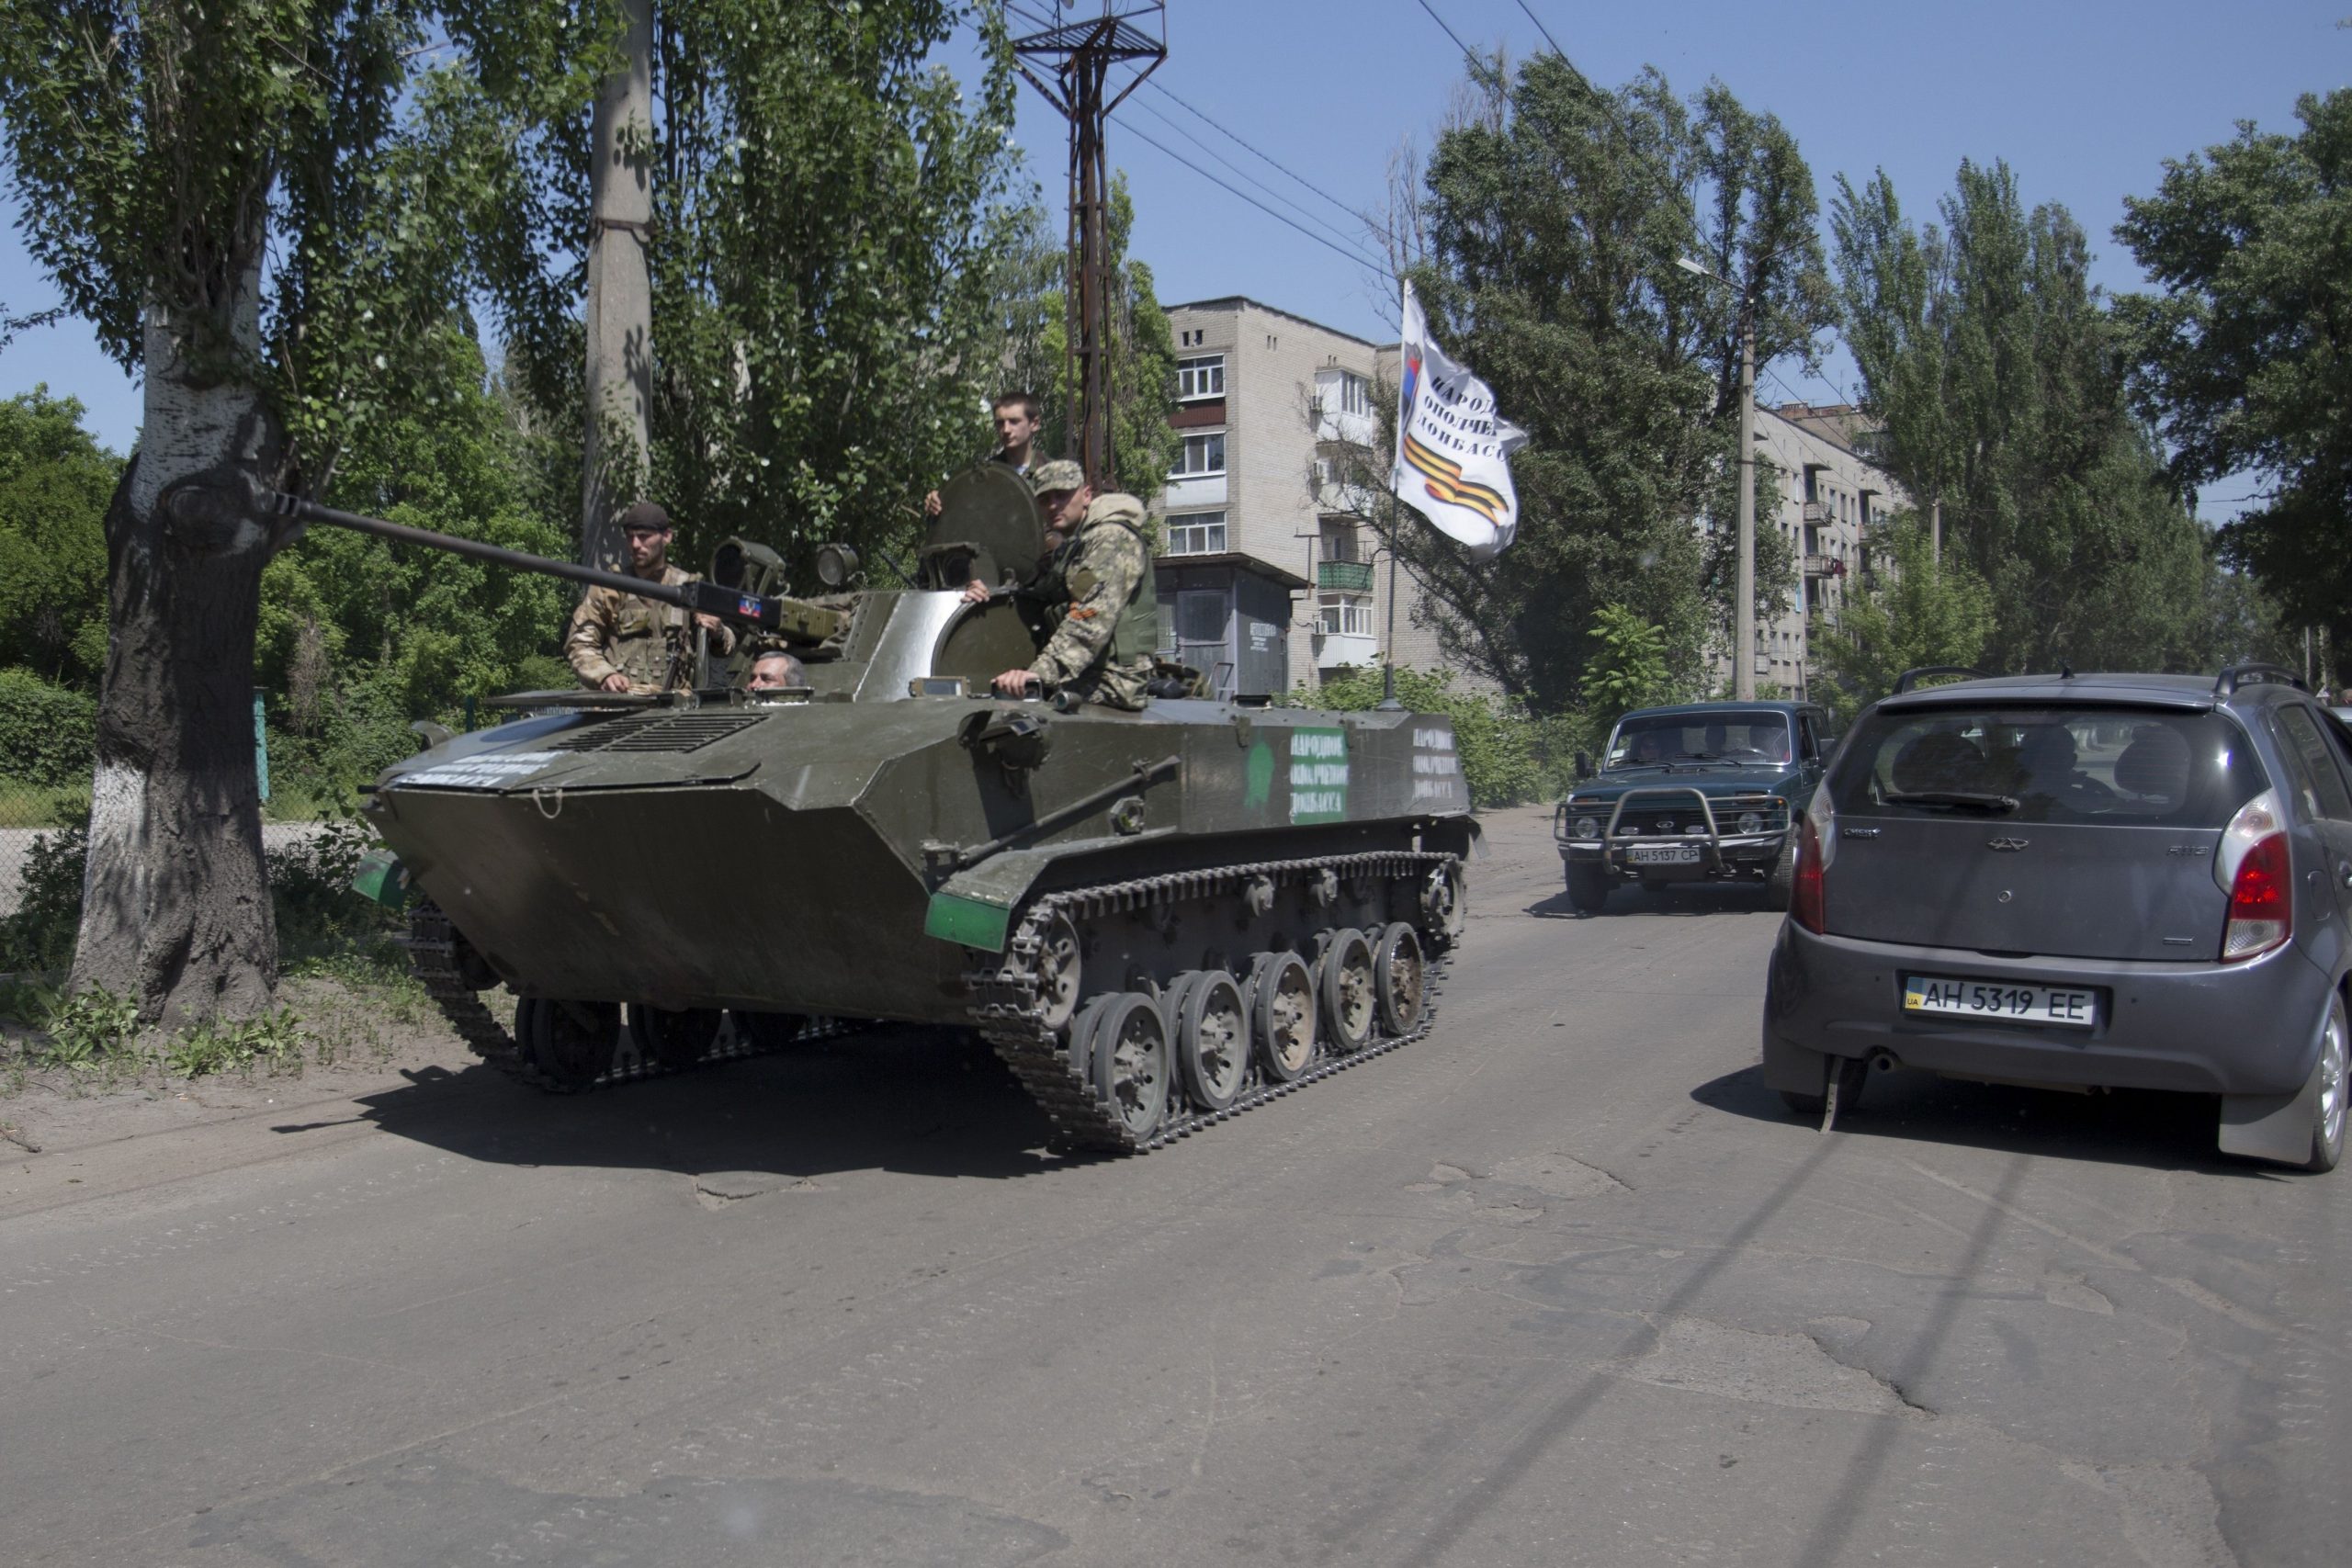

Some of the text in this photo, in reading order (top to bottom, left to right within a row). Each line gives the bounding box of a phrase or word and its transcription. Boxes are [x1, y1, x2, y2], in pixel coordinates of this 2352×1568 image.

[1424, 395, 1497, 436] ОПОЛЧЕ
[1634, 851, 1649, 861] AH
[1652, 851, 1676, 861] 5137
[1907, 998, 1918, 1006] UA
[1924, 983, 2086, 1020] AH 5319 EE
